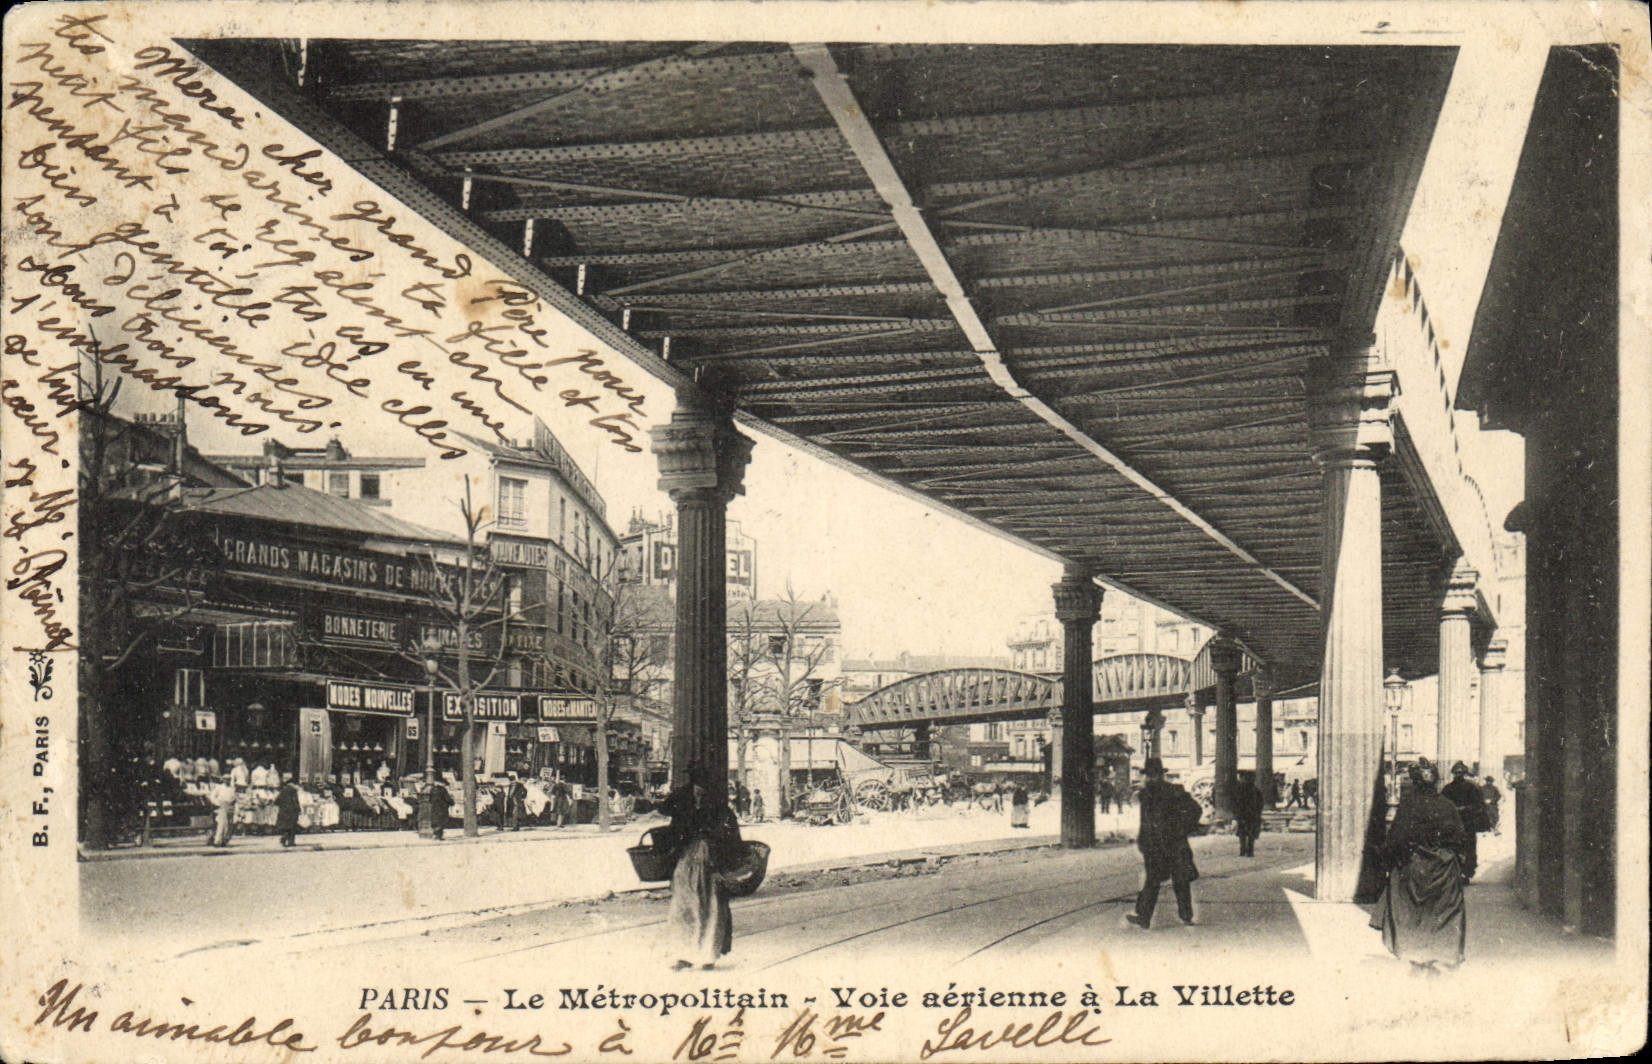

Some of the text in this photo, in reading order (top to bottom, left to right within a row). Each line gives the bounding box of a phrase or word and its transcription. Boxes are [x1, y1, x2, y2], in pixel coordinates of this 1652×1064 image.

[14, 195, 97, 262] sont
[17, 43, 124, 112] petit
[109, 118, 192, 174] fils
[200, 194, 242, 221] se
[448, 351, 533, 415] en
[56, 14, 115, 55] tes
[402, 281, 446, 319] ta
[445, 321, 549, 391] fille
[560, 389, 600, 413] et
[134, 46, 260, 129] Merci
[262, 144, 332, 197] cher
[331, 201, 472, 279] grand
[546, 349, 648, 417] pour
[9, 82, 153, 190] pensant
[153, 194, 181, 223] à
[451, 391, 510, 442] une
[19, 143, 97, 207] bien
[90, 222, 271, 329] gentille
[382, 399, 468, 460] elles
[5, 335, 41, 366] de
[122, 312, 196, 367] trois
[215, 372, 323, 433] nous
[225, 538, 497, 601] GRANDS MAGASINS DE NOUVETES
[325, 615, 397, 640] BONNETERIE
[421, 625, 483, 649] LINAES
[330, 684, 412, 712] MODES NOUVELLES
[446, 696, 518, 717] EXSITION
[110, 997, 319, 1053] aimable
[336, 1007, 575, 1057] bonjour
[599, 1018, 634, 1055] à
